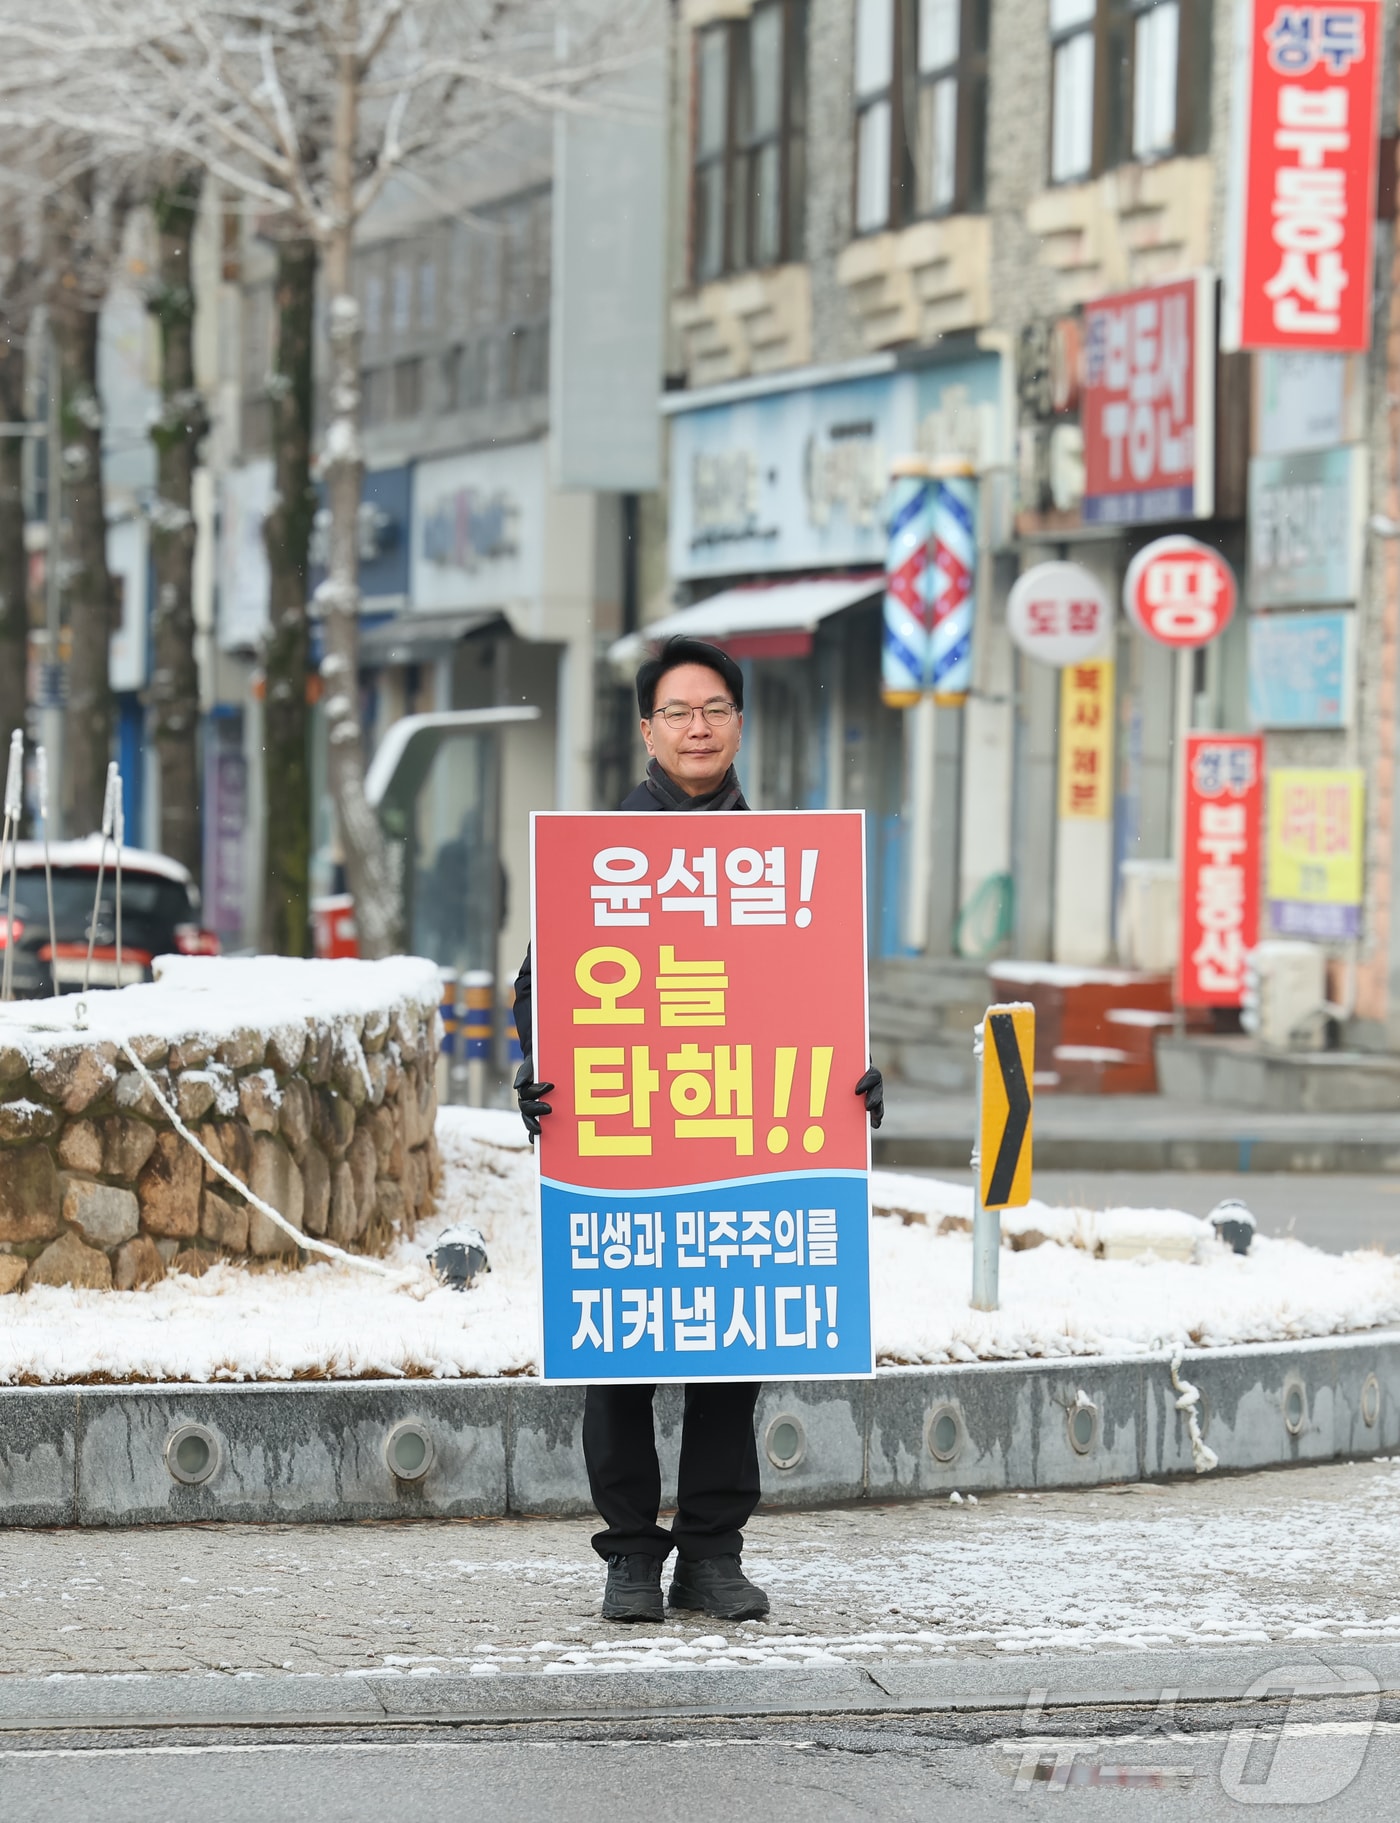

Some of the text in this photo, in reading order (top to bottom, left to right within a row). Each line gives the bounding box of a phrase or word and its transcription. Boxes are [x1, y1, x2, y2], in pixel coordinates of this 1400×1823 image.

[1269, 9, 1362, 72] 성두
[1265, 86, 1350, 333] 부동산
[1028, 601, 1099, 636] 도장
[1144, 560, 1224, 638] 땅
[591, 846, 819, 928] 윤석열!
[1194, 804, 1246, 991] 부동산
[572, 945, 728, 1027] 오늘
[573, 1043, 834, 1157] 탄핵!!
[570, 1208, 838, 1269] 민생과 민주주의를
[571, 1285, 839, 1353] 지켜냅시다!
